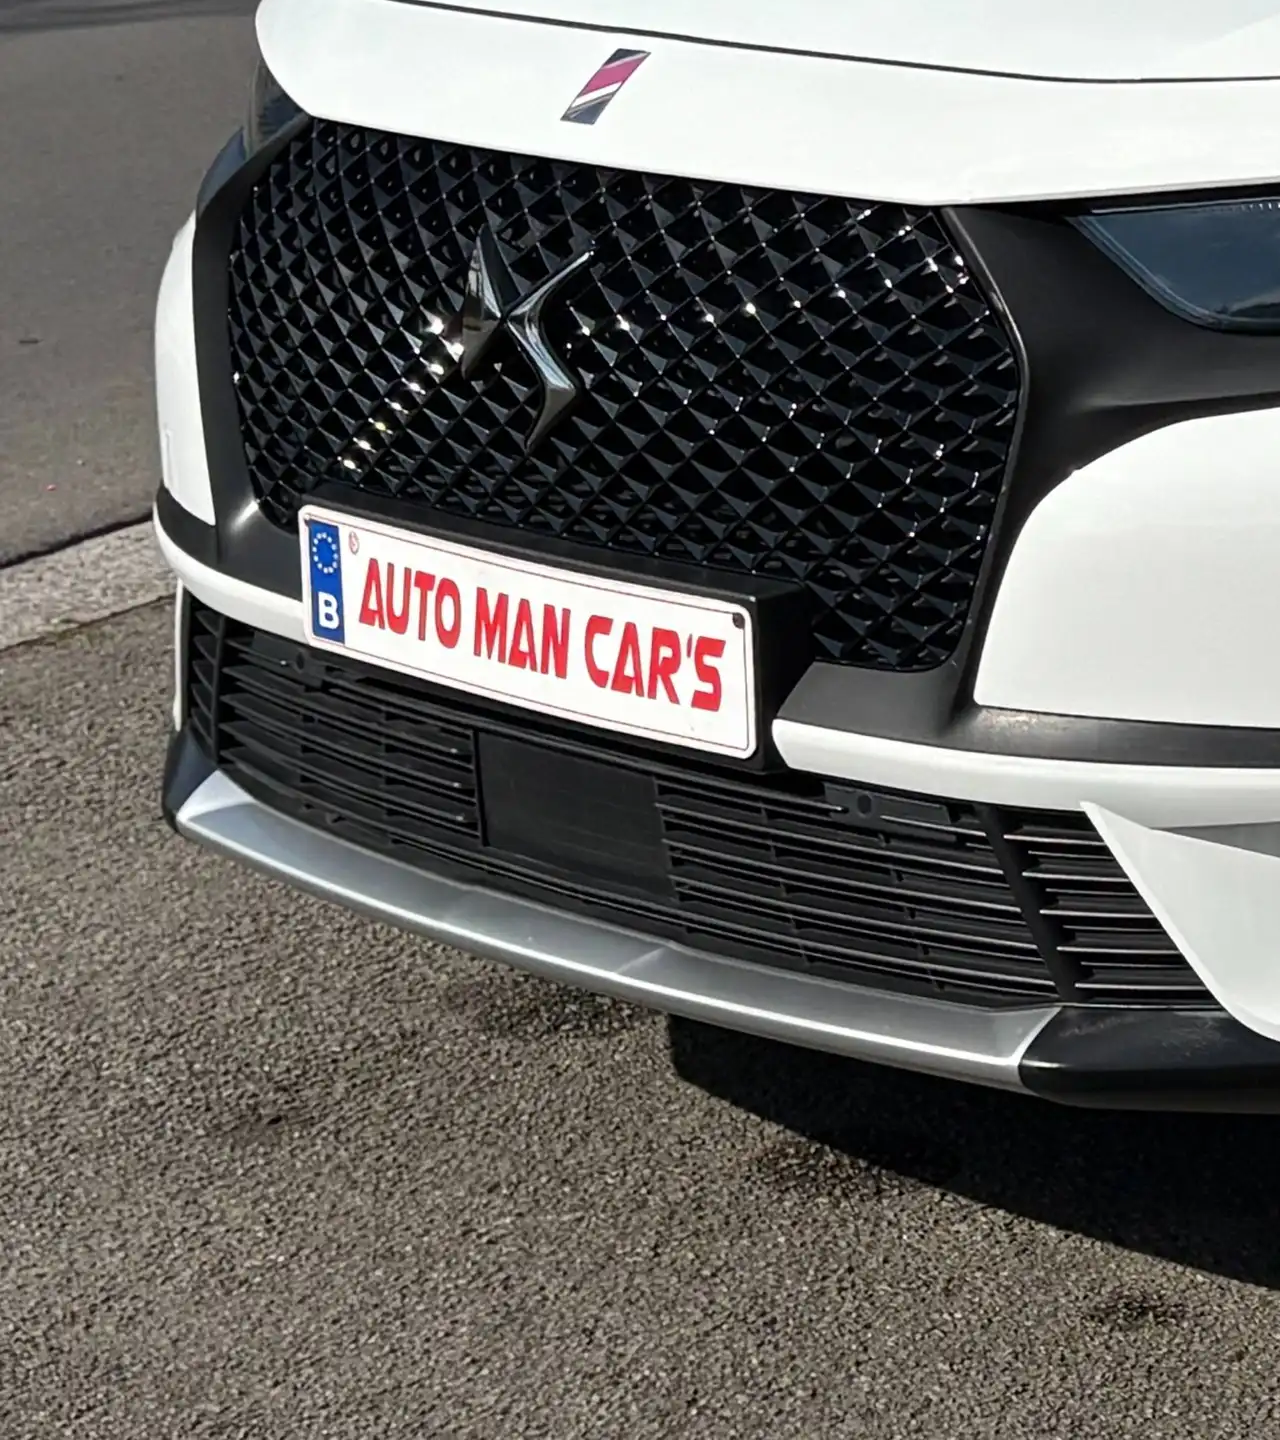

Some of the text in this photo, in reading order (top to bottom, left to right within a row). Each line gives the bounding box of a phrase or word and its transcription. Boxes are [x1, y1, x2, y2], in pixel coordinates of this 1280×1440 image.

[317, 593, 340, 630] B
[358, 557, 462, 650] AUTO
[473, 586, 572, 680] MAN
